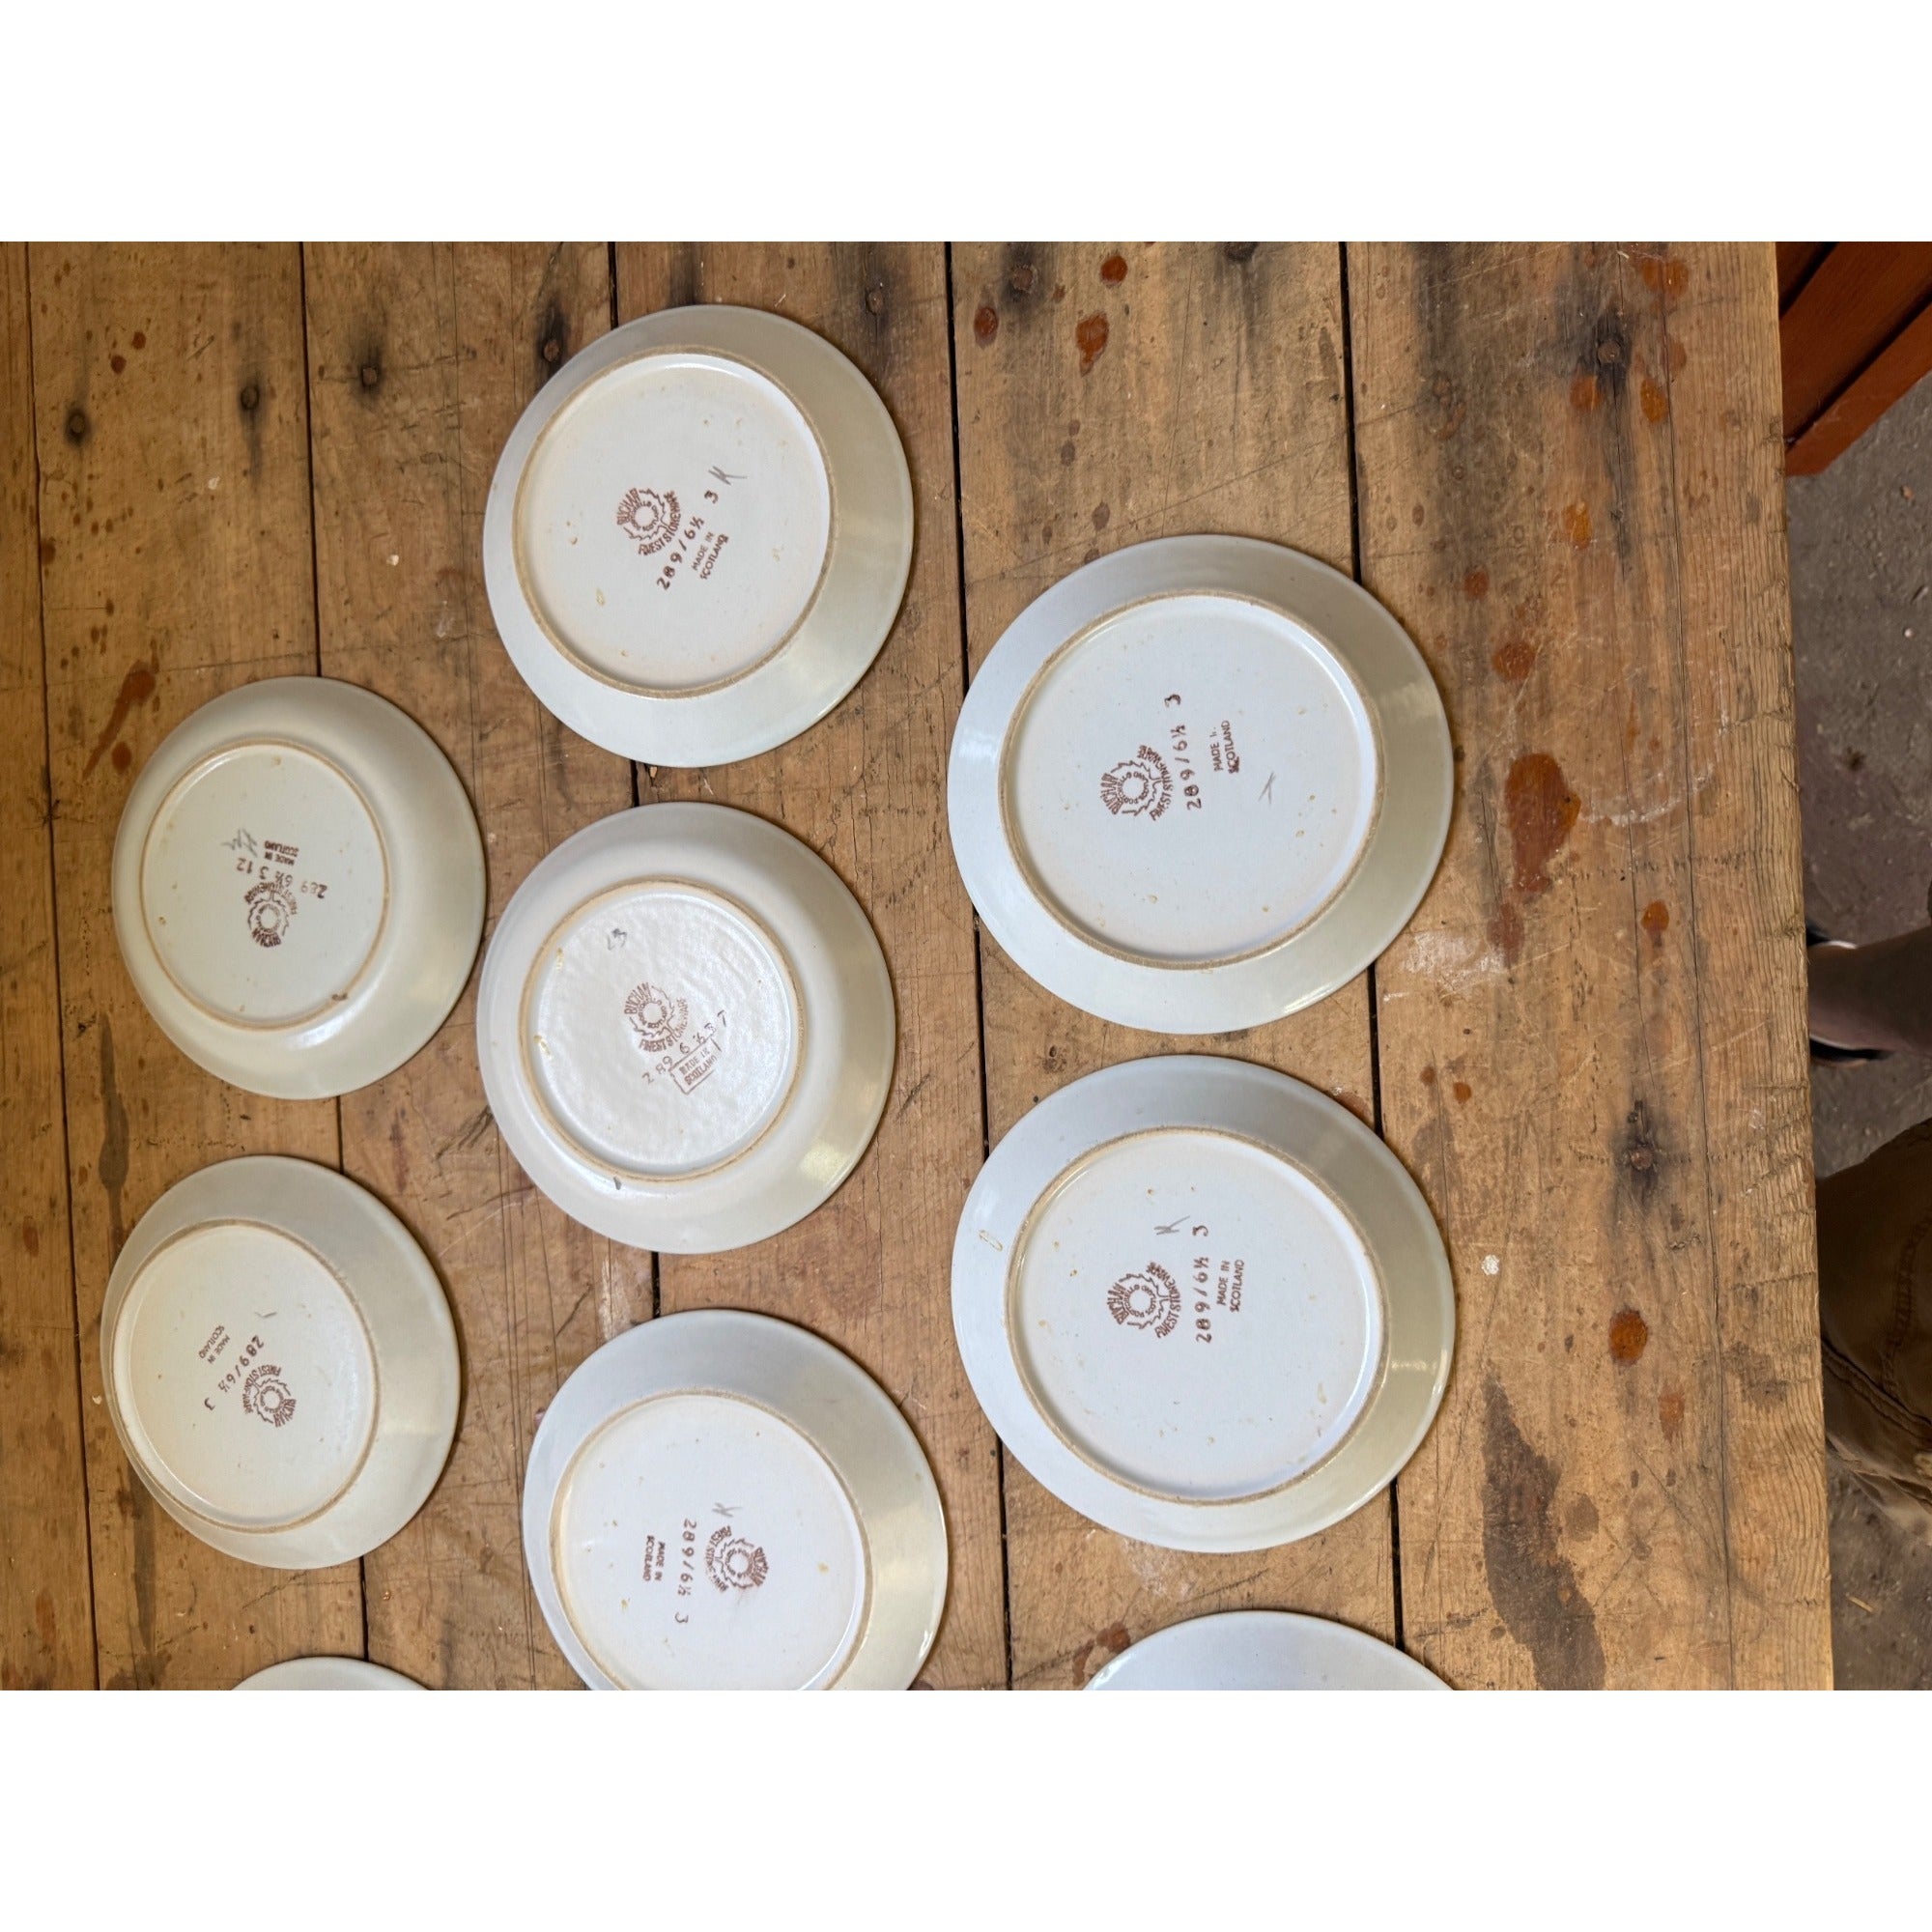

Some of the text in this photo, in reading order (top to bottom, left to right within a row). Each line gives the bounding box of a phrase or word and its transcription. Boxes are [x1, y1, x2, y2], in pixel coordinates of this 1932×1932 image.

[704, 490, 719, 504] 3
[691, 531, 715, 571] MADE IN
[699, 533, 729, 580] SCOTLAND
[1164, 694, 1181, 707] 3
[1210, 741, 1224, 772] MADE
[1220, 720, 1240, 774] SCOTLAND
[264, 839, 300, 858] SCOTLAND
[274, 853, 296, 867] MADE
[624, 981, 653, 1015] BUCHAN
[638, 1038, 668, 1053] FINEST
[678, 1055, 700, 1076] MADE
[683, 1054, 718, 1086] SCOTLAND
[1192, 1225, 1208, 1237] 3
[1216, 1260, 1231, 1306] MADE IN
[1230, 1259, 1245, 1313] SCOTLAND
[198, 1324, 225, 1359] SCOTLAND
[207, 1335, 231, 1364] MADE IN
[642, 1534, 655, 1581] SCOTLAND
[654, 1541, 666, 1581] MADE IN
